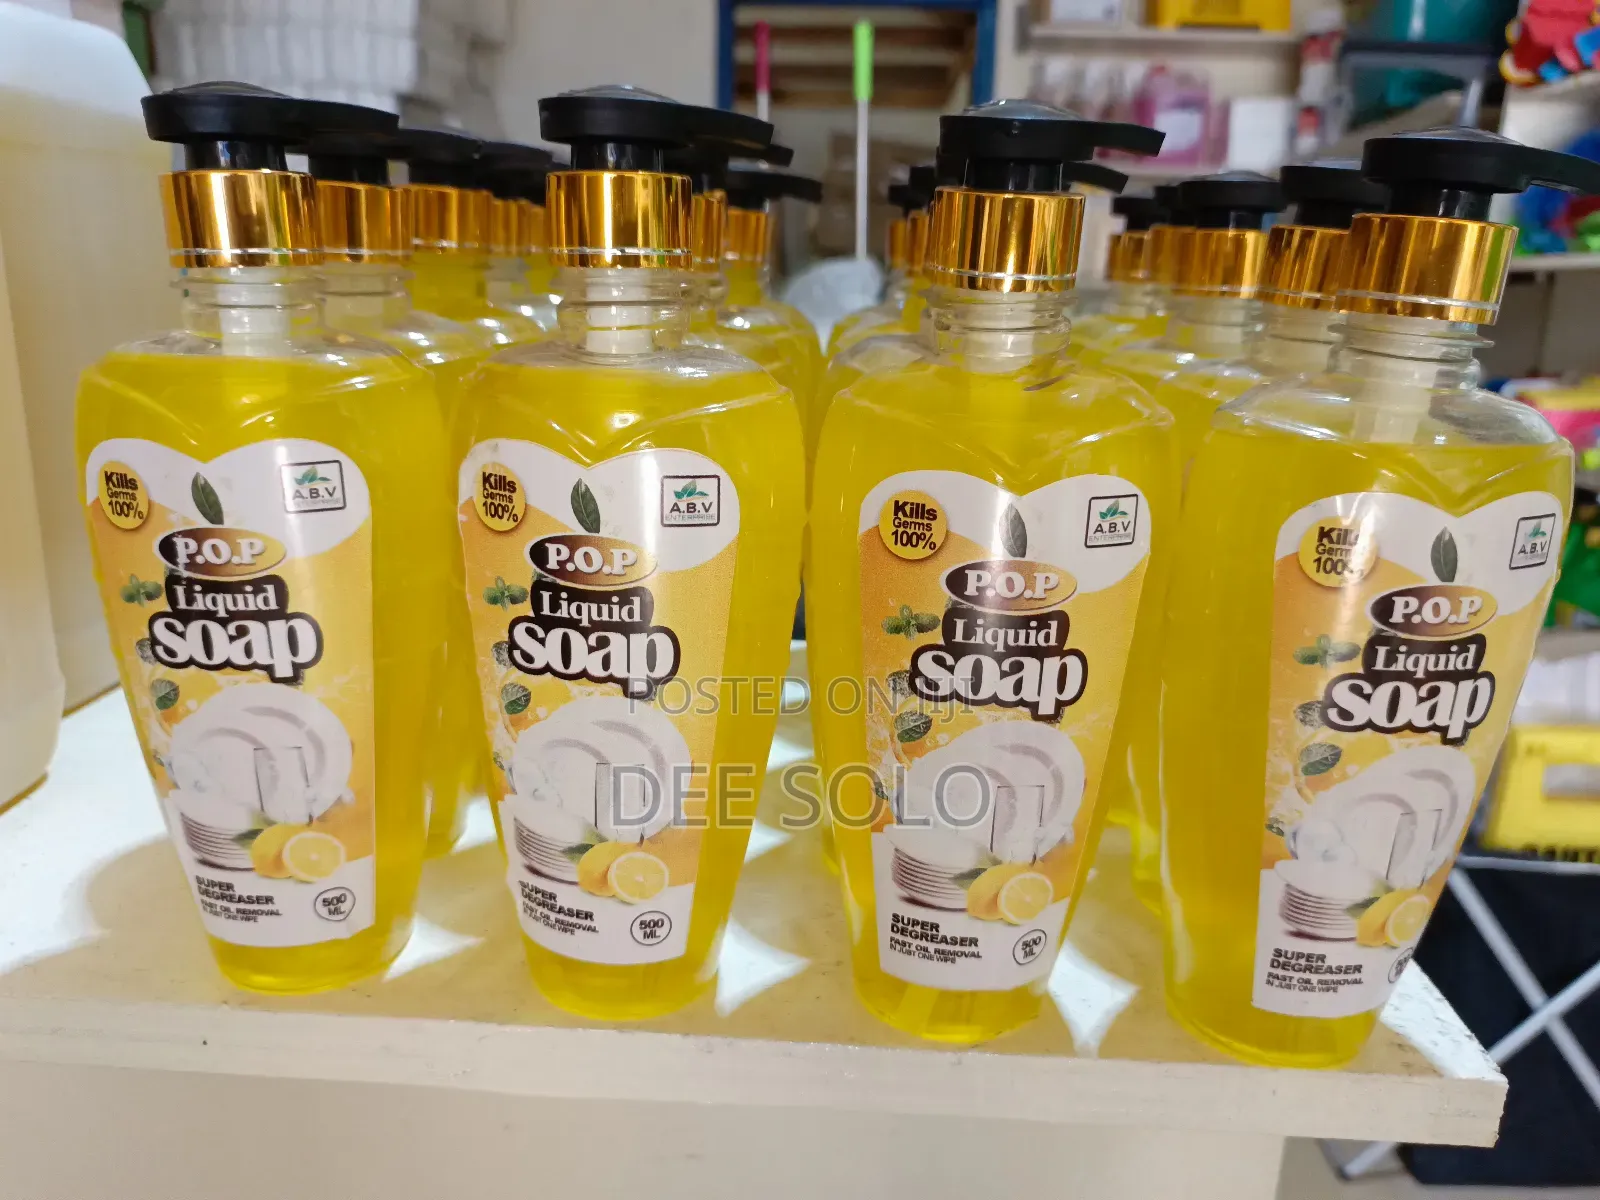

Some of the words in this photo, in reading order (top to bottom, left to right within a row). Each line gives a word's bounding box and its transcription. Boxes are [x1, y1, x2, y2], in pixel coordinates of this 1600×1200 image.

[104, 471, 138, 490] Kills
[482, 471, 517, 494] Kills
[107, 488, 136, 501] Germs
[292, 486, 336, 500] A.B.V
[483, 488, 514, 504] Germs
[109, 499, 144, 519] 100%
[482, 501, 518, 522] 100%
[669, 501, 713, 513] A.B.V
[893, 500, 937, 521] Kills
[893, 517, 932, 532] Germs
[1093, 520, 1131, 534] A.B.V
[891, 529, 936, 551] 100%
[1518, 540, 1547, 555] A.B.V
[173, 536, 265, 565] P.O.P
[545, 543, 636, 575] P.O.P
[964, 569, 1059, 599] P.O.P
[174, 581, 279, 617] Liquid
[540, 591, 642, 627] Liquid
[1390, 596, 1483, 624] P.O.P
[952, 619, 1058, 652] Liquid
[152, 618, 317, 677] soap
[513, 622, 674, 692] soap
[1371, 644, 1477, 678] Liquid
[917, 650, 1083, 715] soap
[1326, 677, 1492, 738] soap
[196, 875, 235, 892] SUPER
[518, 880, 557, 902] SUPER
[198, 885, 275, 905] DEGREASER
[322, 893, 347, 907] 500
[521, 888, 594, 921] DEGREASER
[328, 907, 346, 916] ML
[639, 918, 665, 930] 500
[892, 913, 940, 933] SUPER
[643, 929, 661, 940] ML
[891, 923, 979, 947] DEGREASER
[1021, 935, 1042, 951] 500
[890, 936, 913, 949] FAST
[915, 944, 931, 954] OIL
[934, 948, 982, 959] REMOVAL
[917, 951, 935, 962] ONE
[936, 956, 957, 964] WIPE
[1023, 948, 1036, 960] ML
[1272, 948, 1326, 964] SUPER
[1270, 958, 1363, 975] DEGREASER
[1267, 972, 1294, 983] FAST
[1317, 978, 1363, 986] REMOVAL
